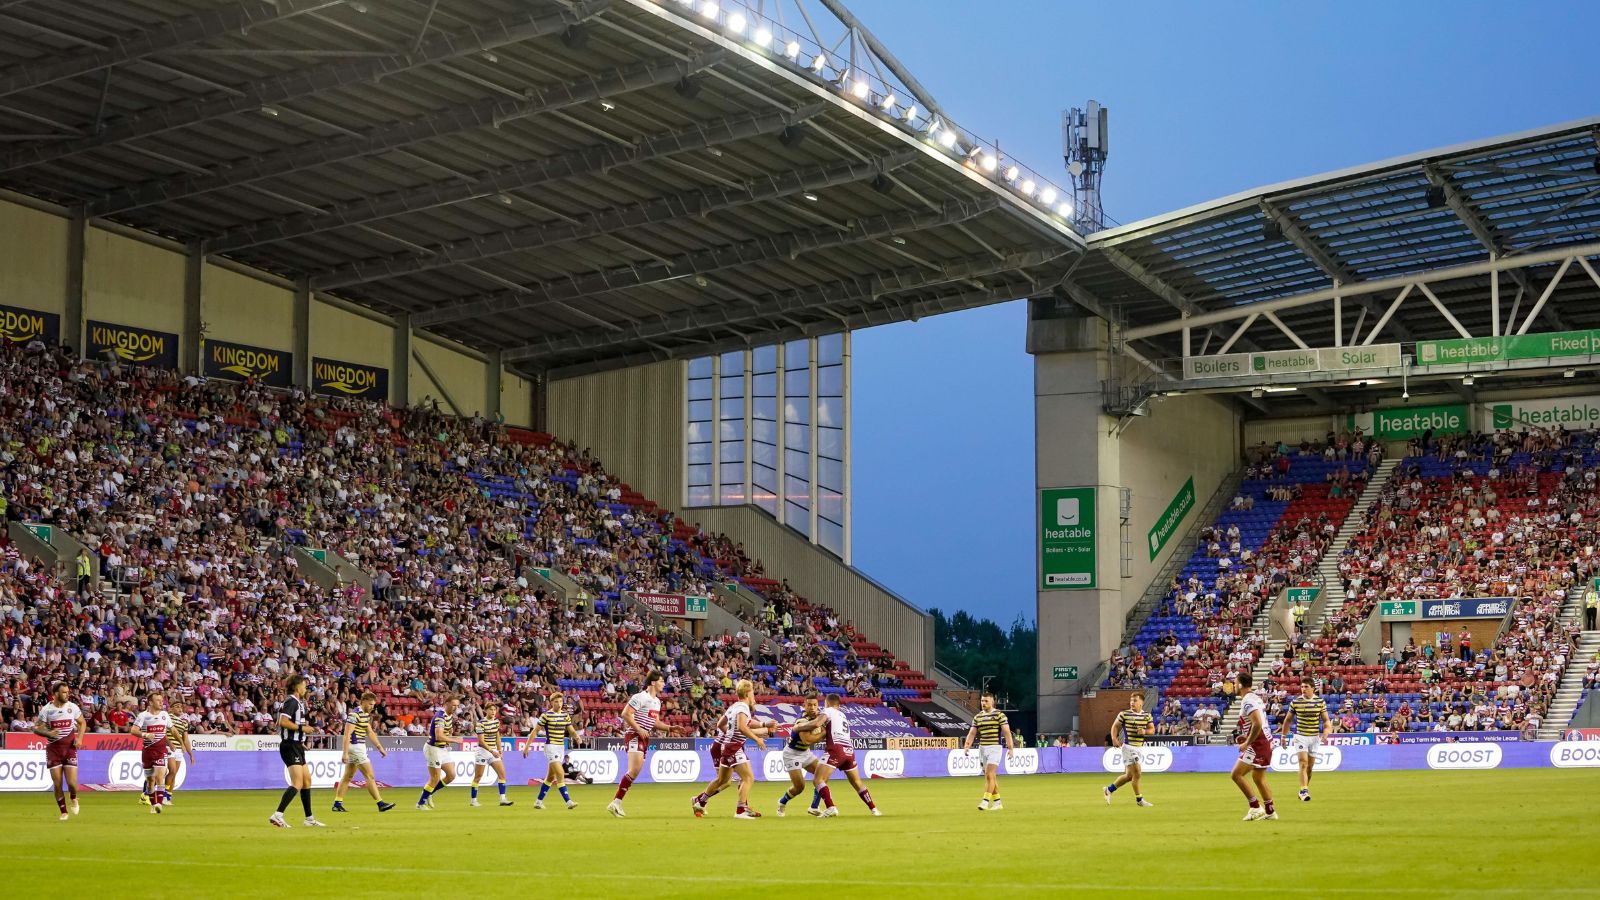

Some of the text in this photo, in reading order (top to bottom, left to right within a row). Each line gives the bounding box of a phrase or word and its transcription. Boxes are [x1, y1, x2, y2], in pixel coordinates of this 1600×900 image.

[0, 310, 44, 335] GDOM
[92, 326, 164, 355] KINGDOM
[1440, 342, 1499, 358] heatable
[1551, 336, 1588, 351] Fixed
[213, 346, 279, 371] KINGDOM
[1268, 355, 1315, 369] heatable
[1342, 352, 1377, 365] Solar
[1194, 360, 1240, 374] Boilers
[315, 363, 376, 387] KINGDOM
[1518, 404, 1600, 424] heatable
[1379, 411, 1460, 432] heatable
[1158, 490, 1192, 541] heatable.co.uk
[1045, 527, 1091, 539] heatable
[191, 739, 227, 748] Greenmount
[257, 739, 280, 748] Greenm
[898, 738, 948, 748] FIELDEN FACTORS
[1279, 752, 1334, 765] BOST
[1437, 750, 1494, 763] BOOST
[1560, 747, 1600, 761] BOO
[657, 759, 695, 774] BOOST
[869, 757, 900, 771] BOOST
[952, 756, 980, 769] BOOST
[1009, 755, 1035, 768] BOOST
[0, 761, 47, 780] OOST
[308, 761, 344, 778] OOST
